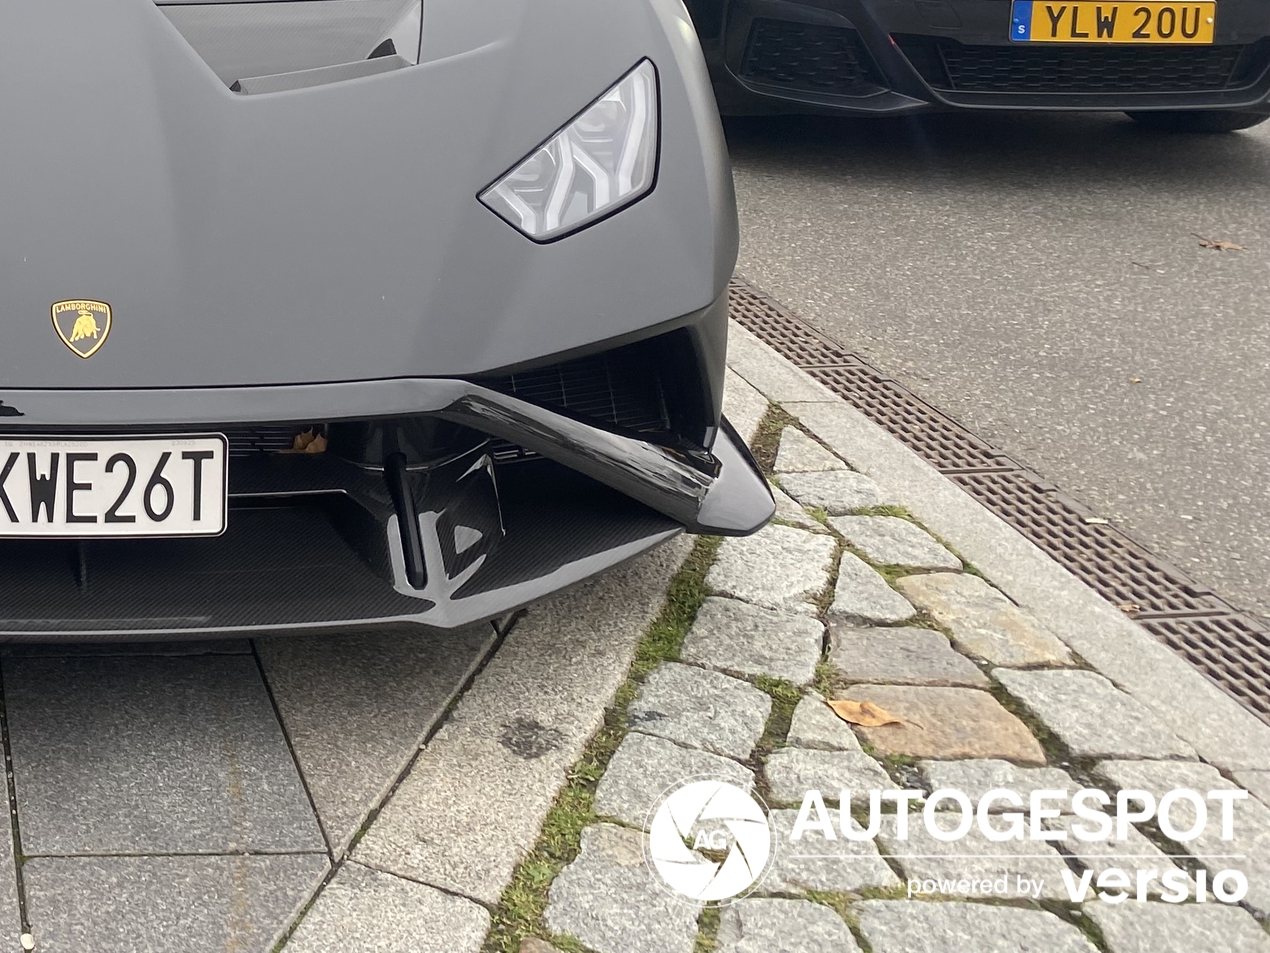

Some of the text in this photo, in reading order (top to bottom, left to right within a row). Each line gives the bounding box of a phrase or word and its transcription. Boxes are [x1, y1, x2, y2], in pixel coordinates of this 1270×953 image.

[1045, 5, 1201, 39] YLW 20U
[1018, 25, 1026, 34] S
[56, 303, 106, 313] LAMBORGHINI
